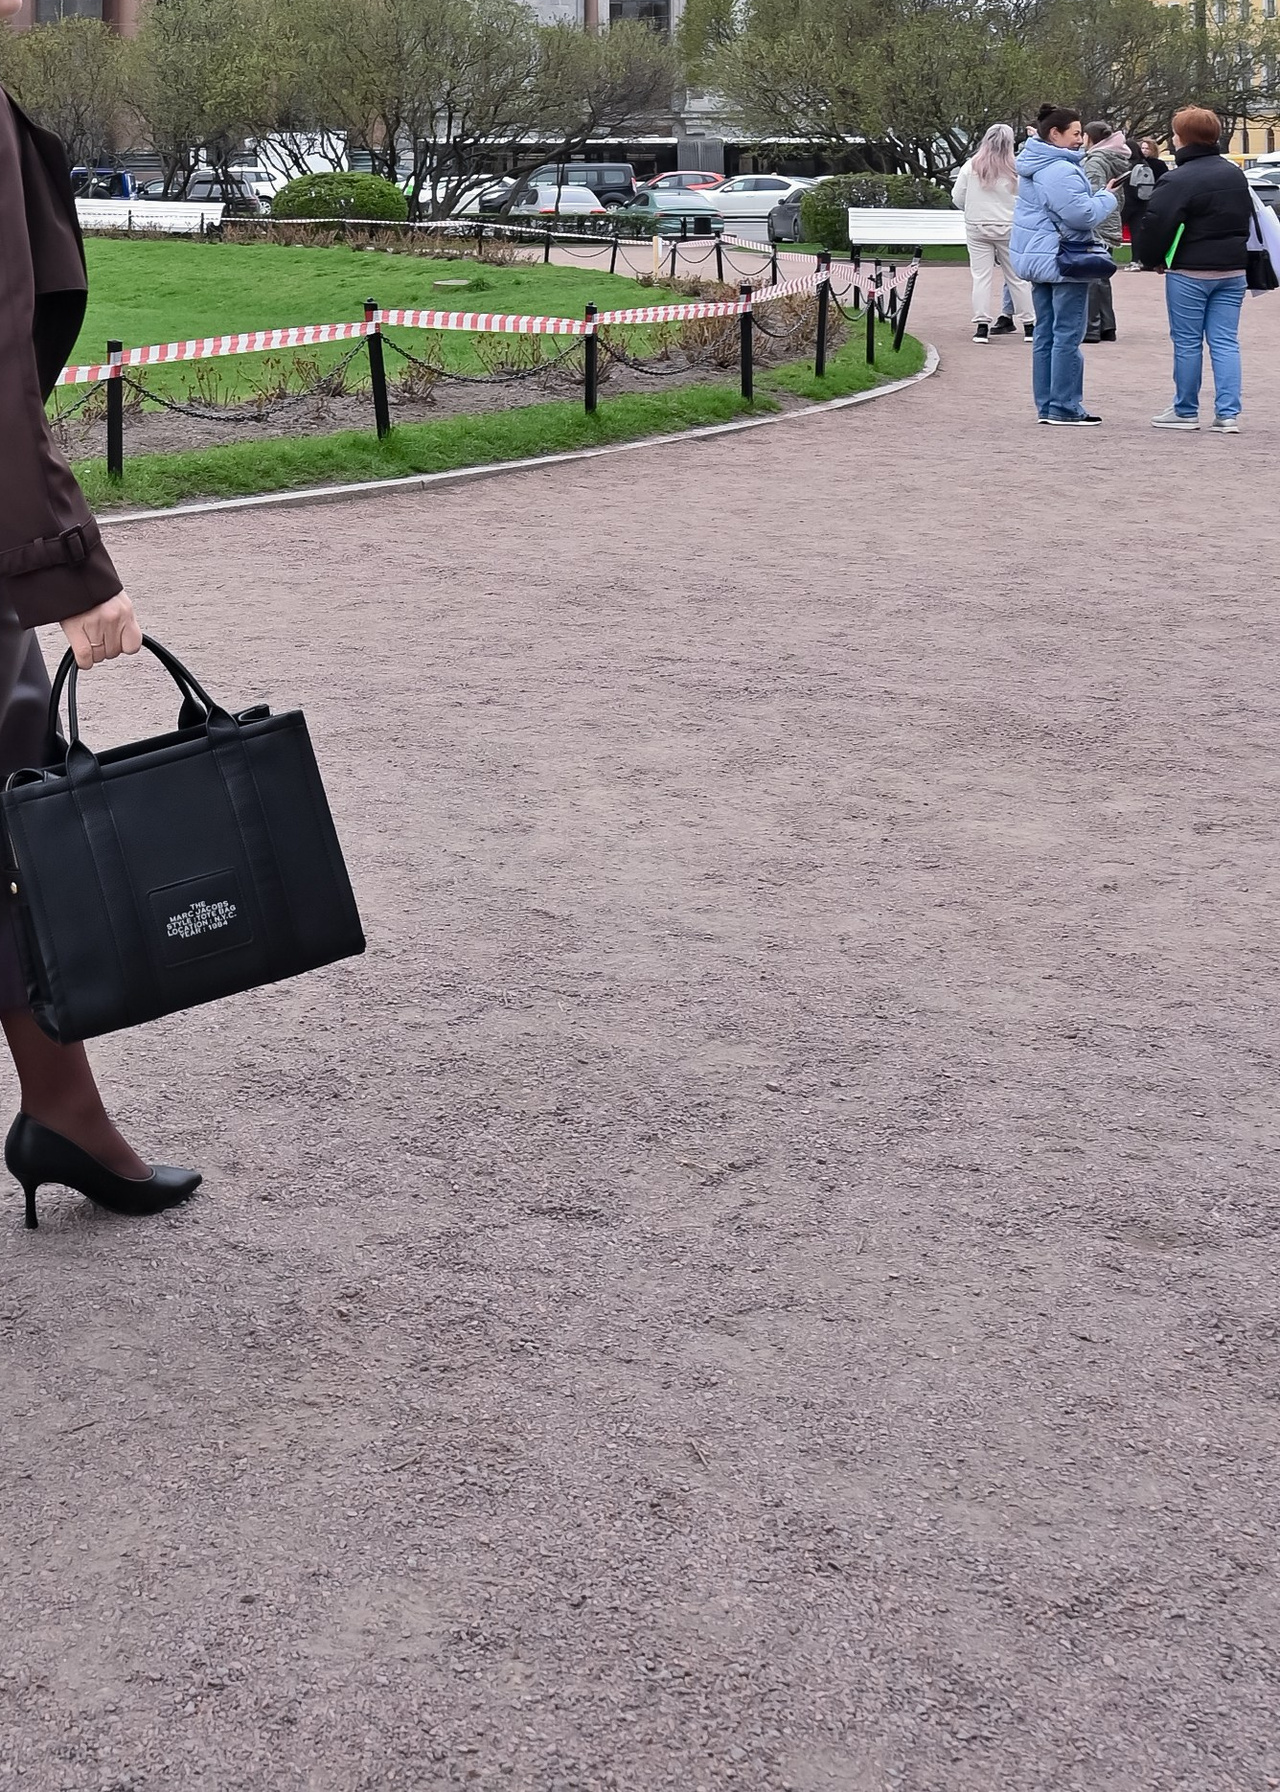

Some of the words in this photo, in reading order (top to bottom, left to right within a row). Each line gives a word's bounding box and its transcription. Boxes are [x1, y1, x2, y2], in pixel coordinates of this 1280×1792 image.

[169, 910, 194, 922] MARC
[195, 900, 229, 915] JACOBS
[190, 901, 206, 910] THE
[166, 918, 192, 930] STYLE
[167, 919, 208, 936] LOCATION
[180, 927, 202, 939] YEAR
